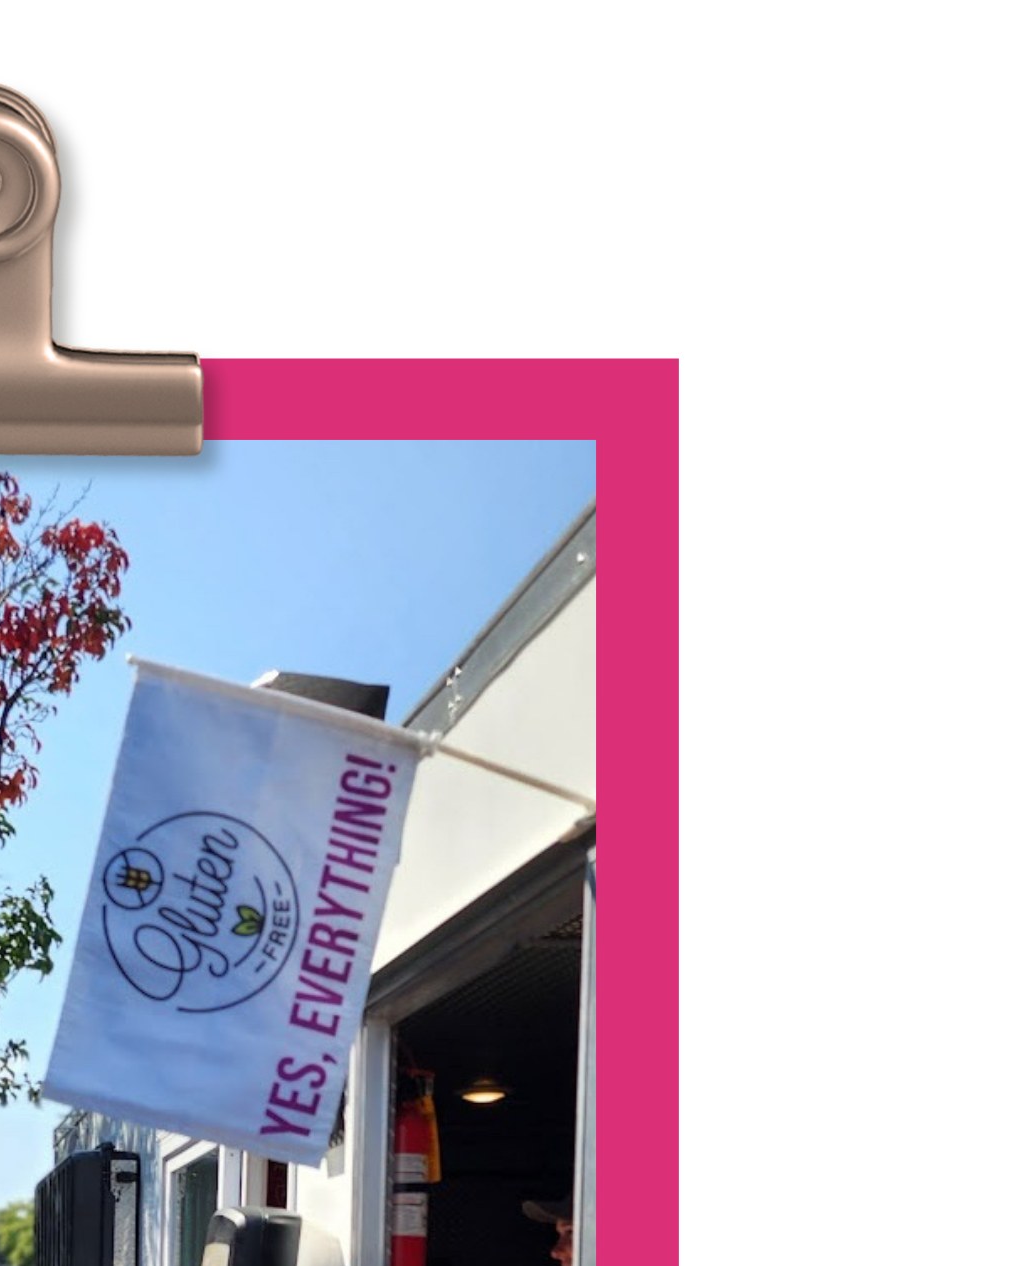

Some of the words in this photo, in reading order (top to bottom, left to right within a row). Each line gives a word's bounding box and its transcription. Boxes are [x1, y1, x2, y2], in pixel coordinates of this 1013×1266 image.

[134, 828, 238, 1000] Gluten
[290, 754, 397, 1036] EVERYTHING!
[260, 1053, 337, 1138] YES,
